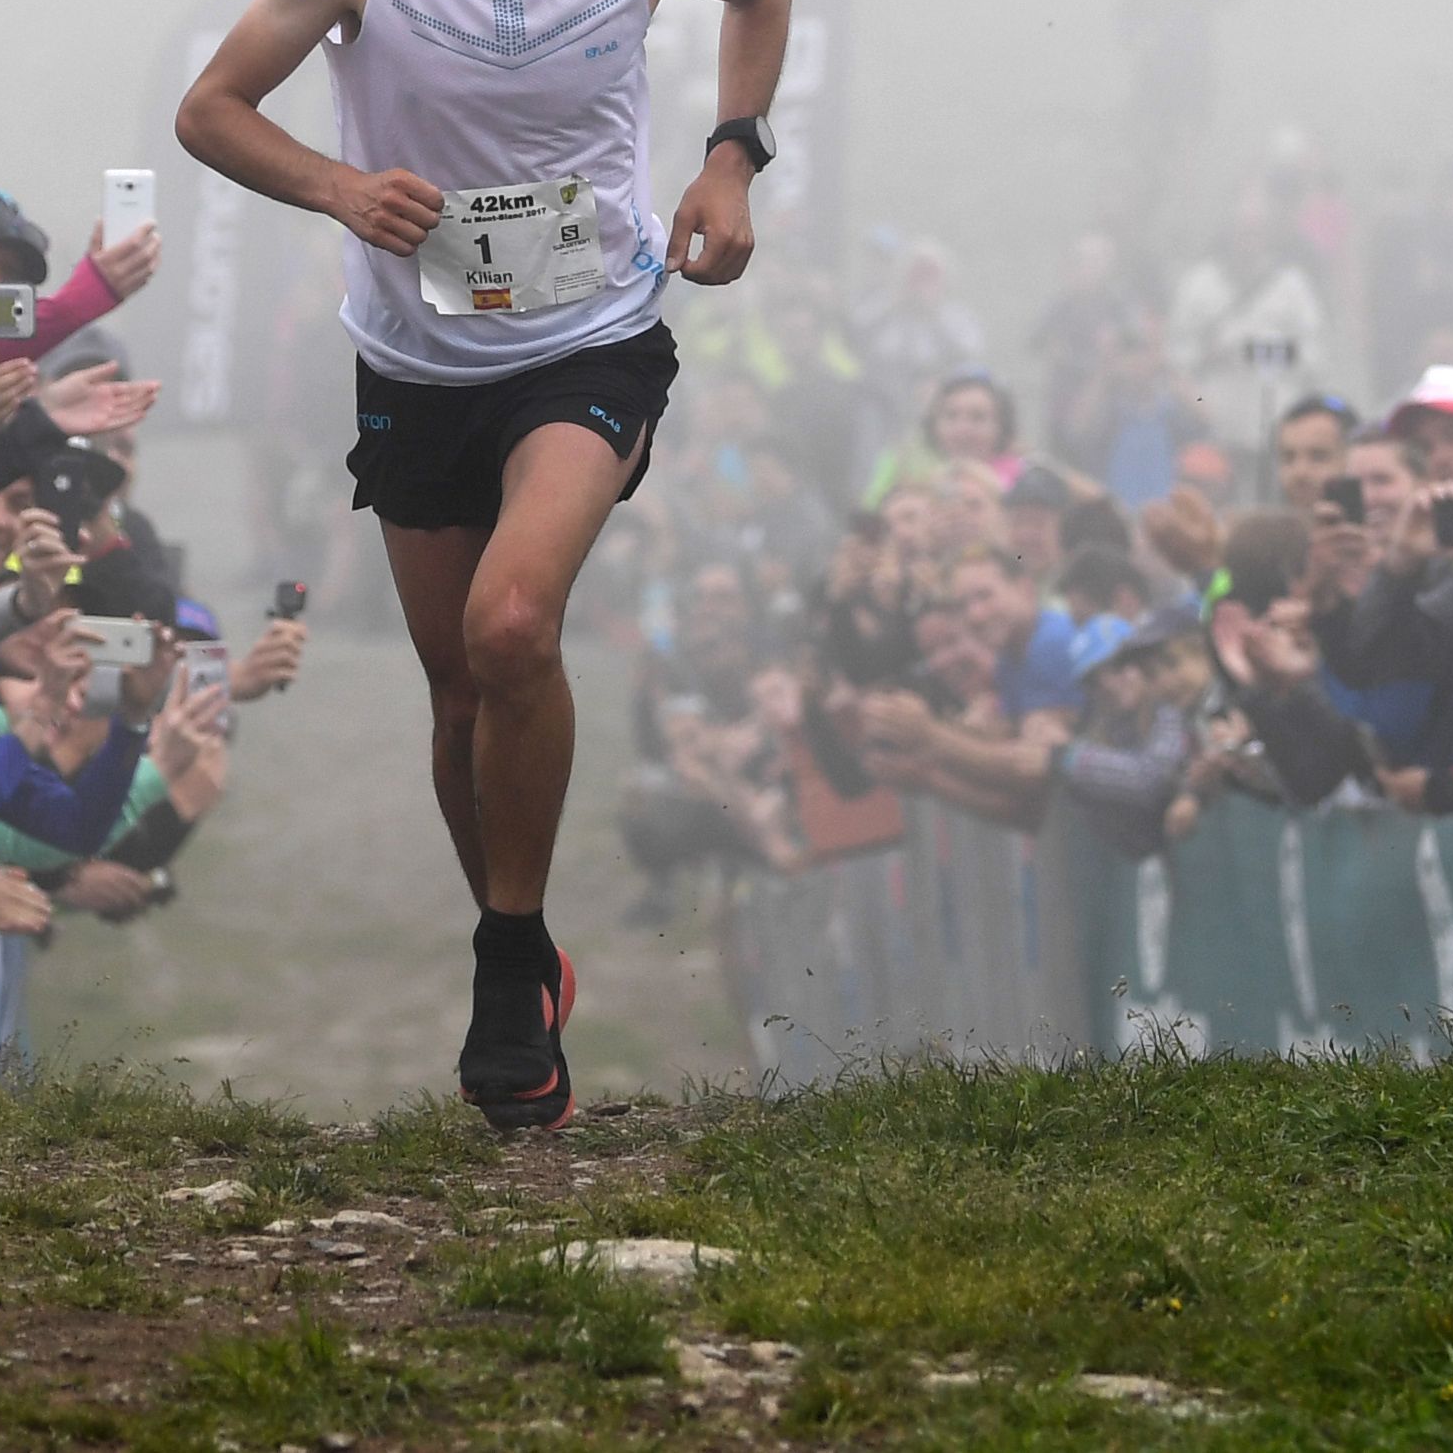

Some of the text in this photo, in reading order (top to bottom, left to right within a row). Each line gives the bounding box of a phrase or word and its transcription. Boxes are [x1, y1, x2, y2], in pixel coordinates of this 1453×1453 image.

[470, 194, 535, 213] 42km
[474, 213, 524, 223] Mont-Blanc
[526, 207, 547, 217] 2017
[474, 234, 493, 264] 1
[466, 271, 513, 285] Kilian
